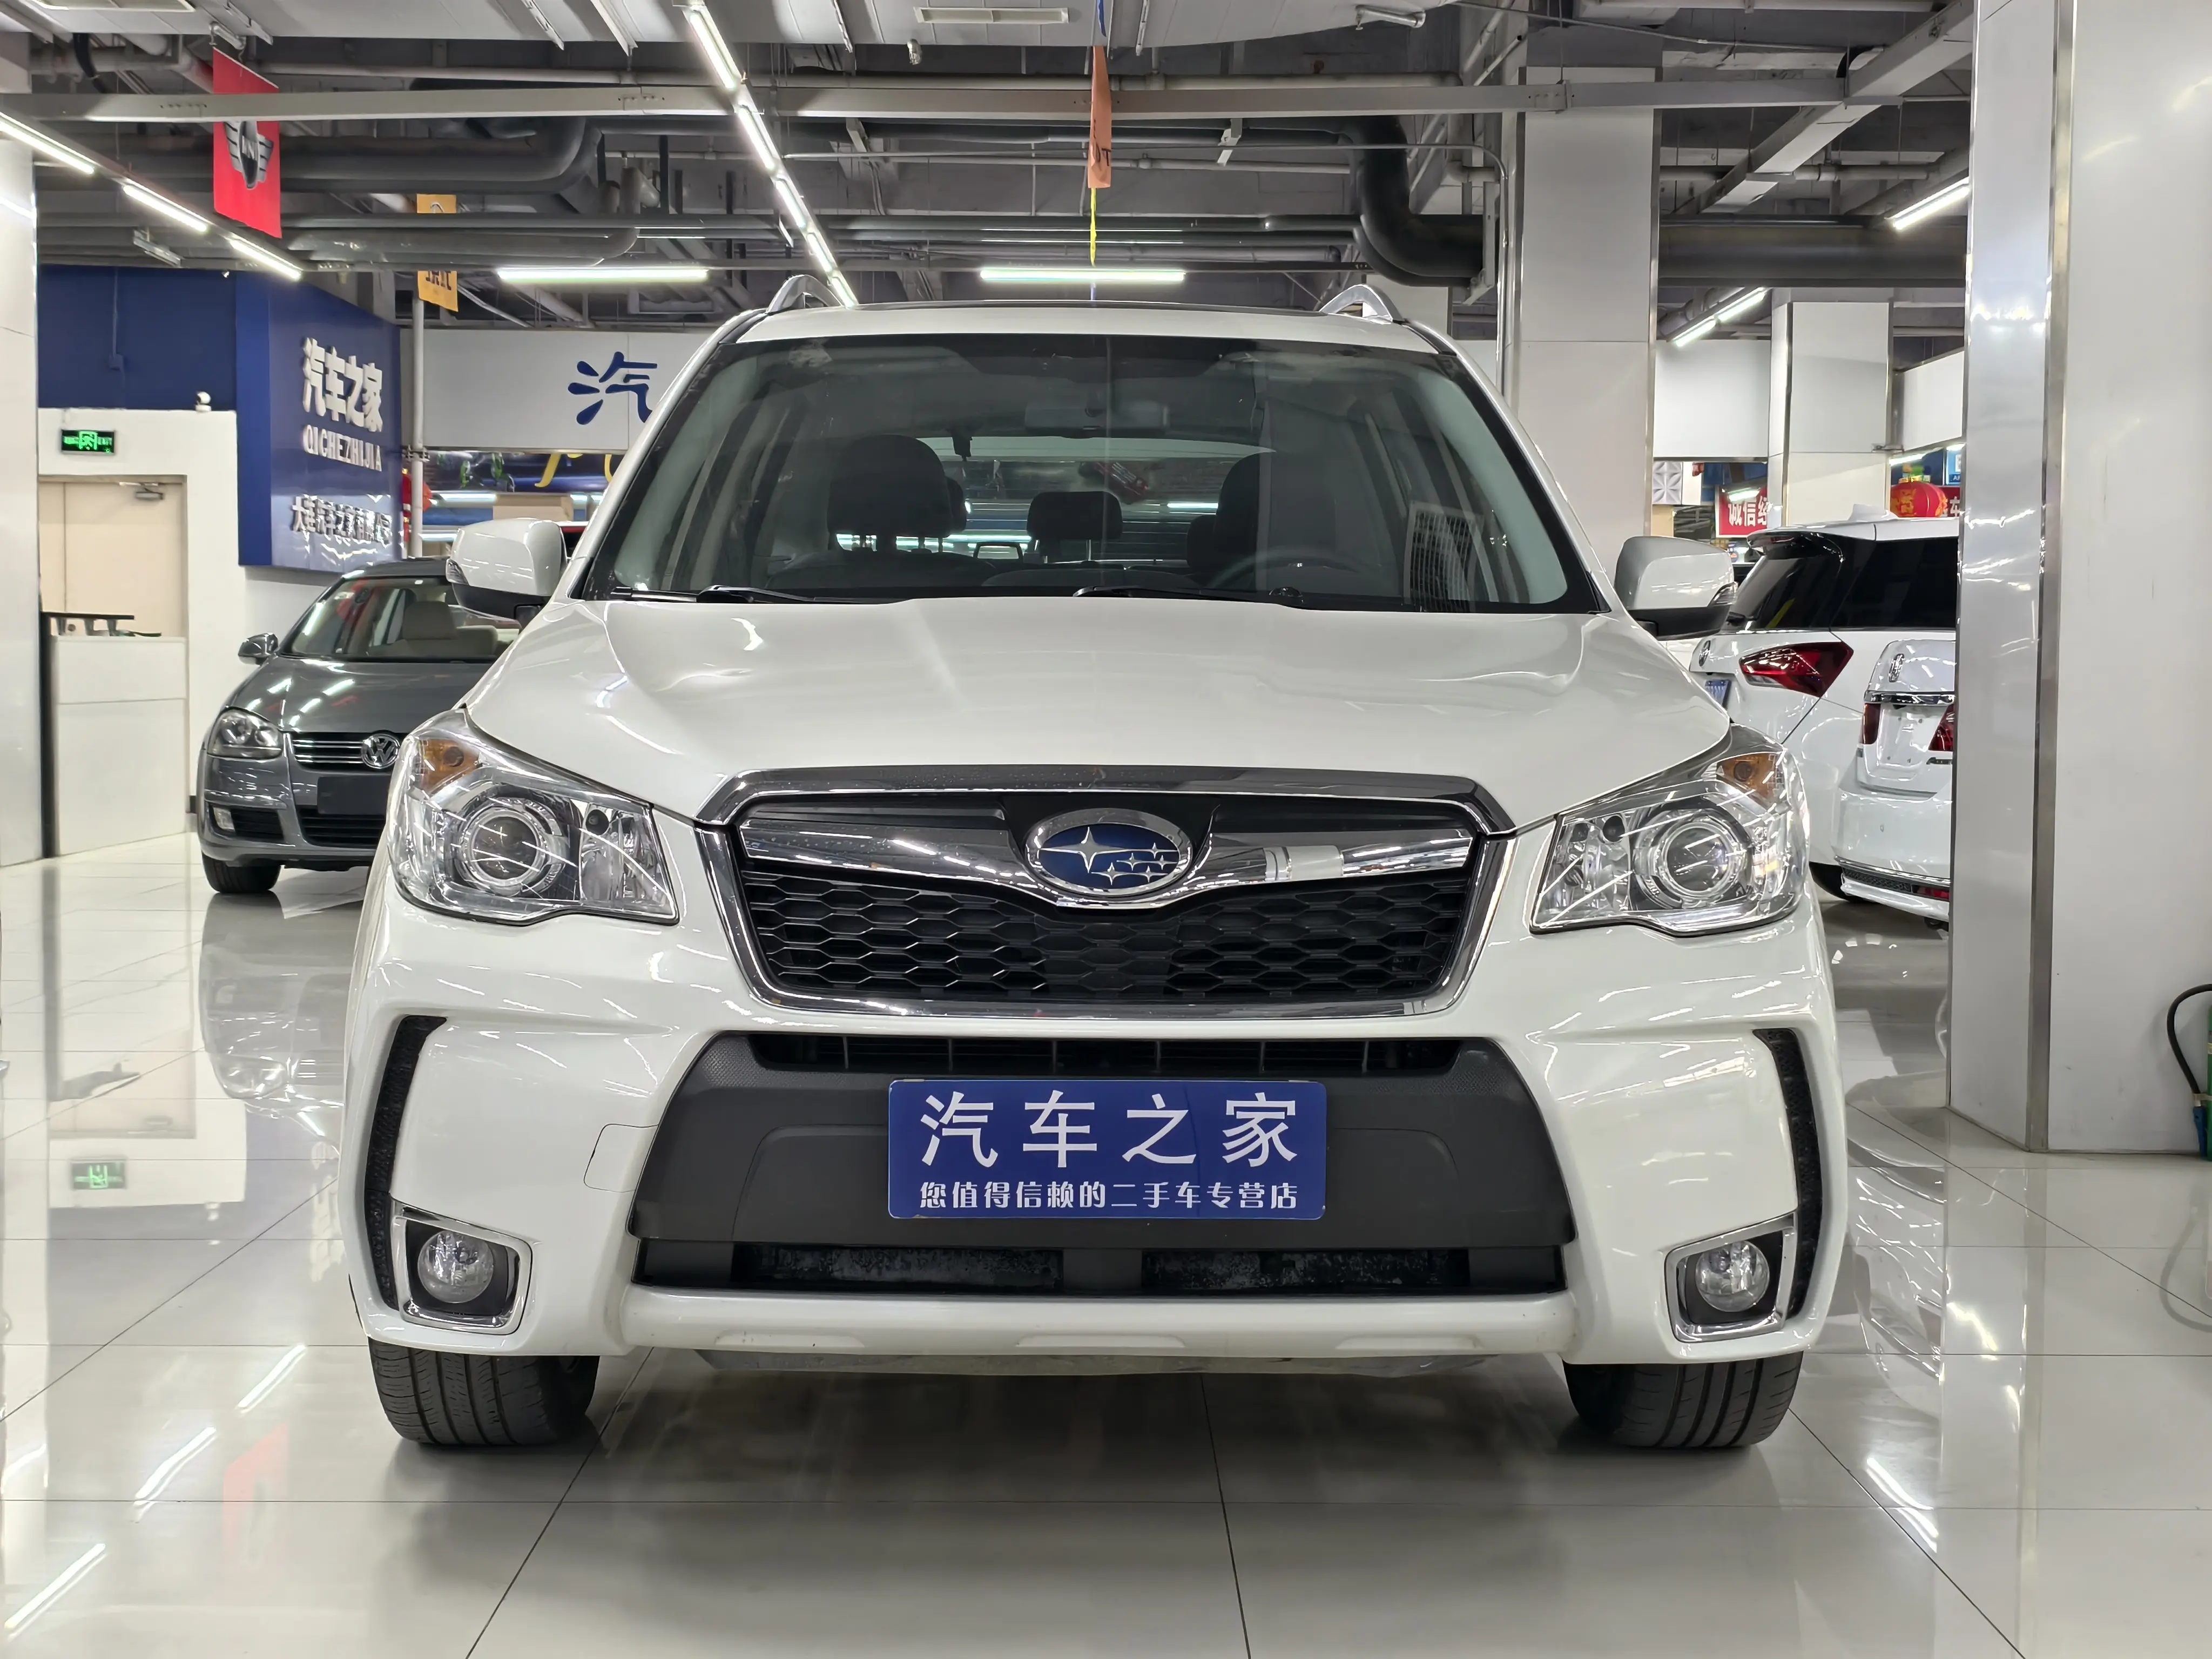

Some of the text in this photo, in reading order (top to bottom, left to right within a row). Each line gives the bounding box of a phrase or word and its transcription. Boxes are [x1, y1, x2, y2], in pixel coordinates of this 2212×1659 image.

[302, 337, 383, 433] 汽车之家
[568, 351, 658, 425] 汽
[920, 1090, 1298, 1169] 汽车之家
[920, 1181, 1298, 1210] 您值得信赖的二手车专营店
